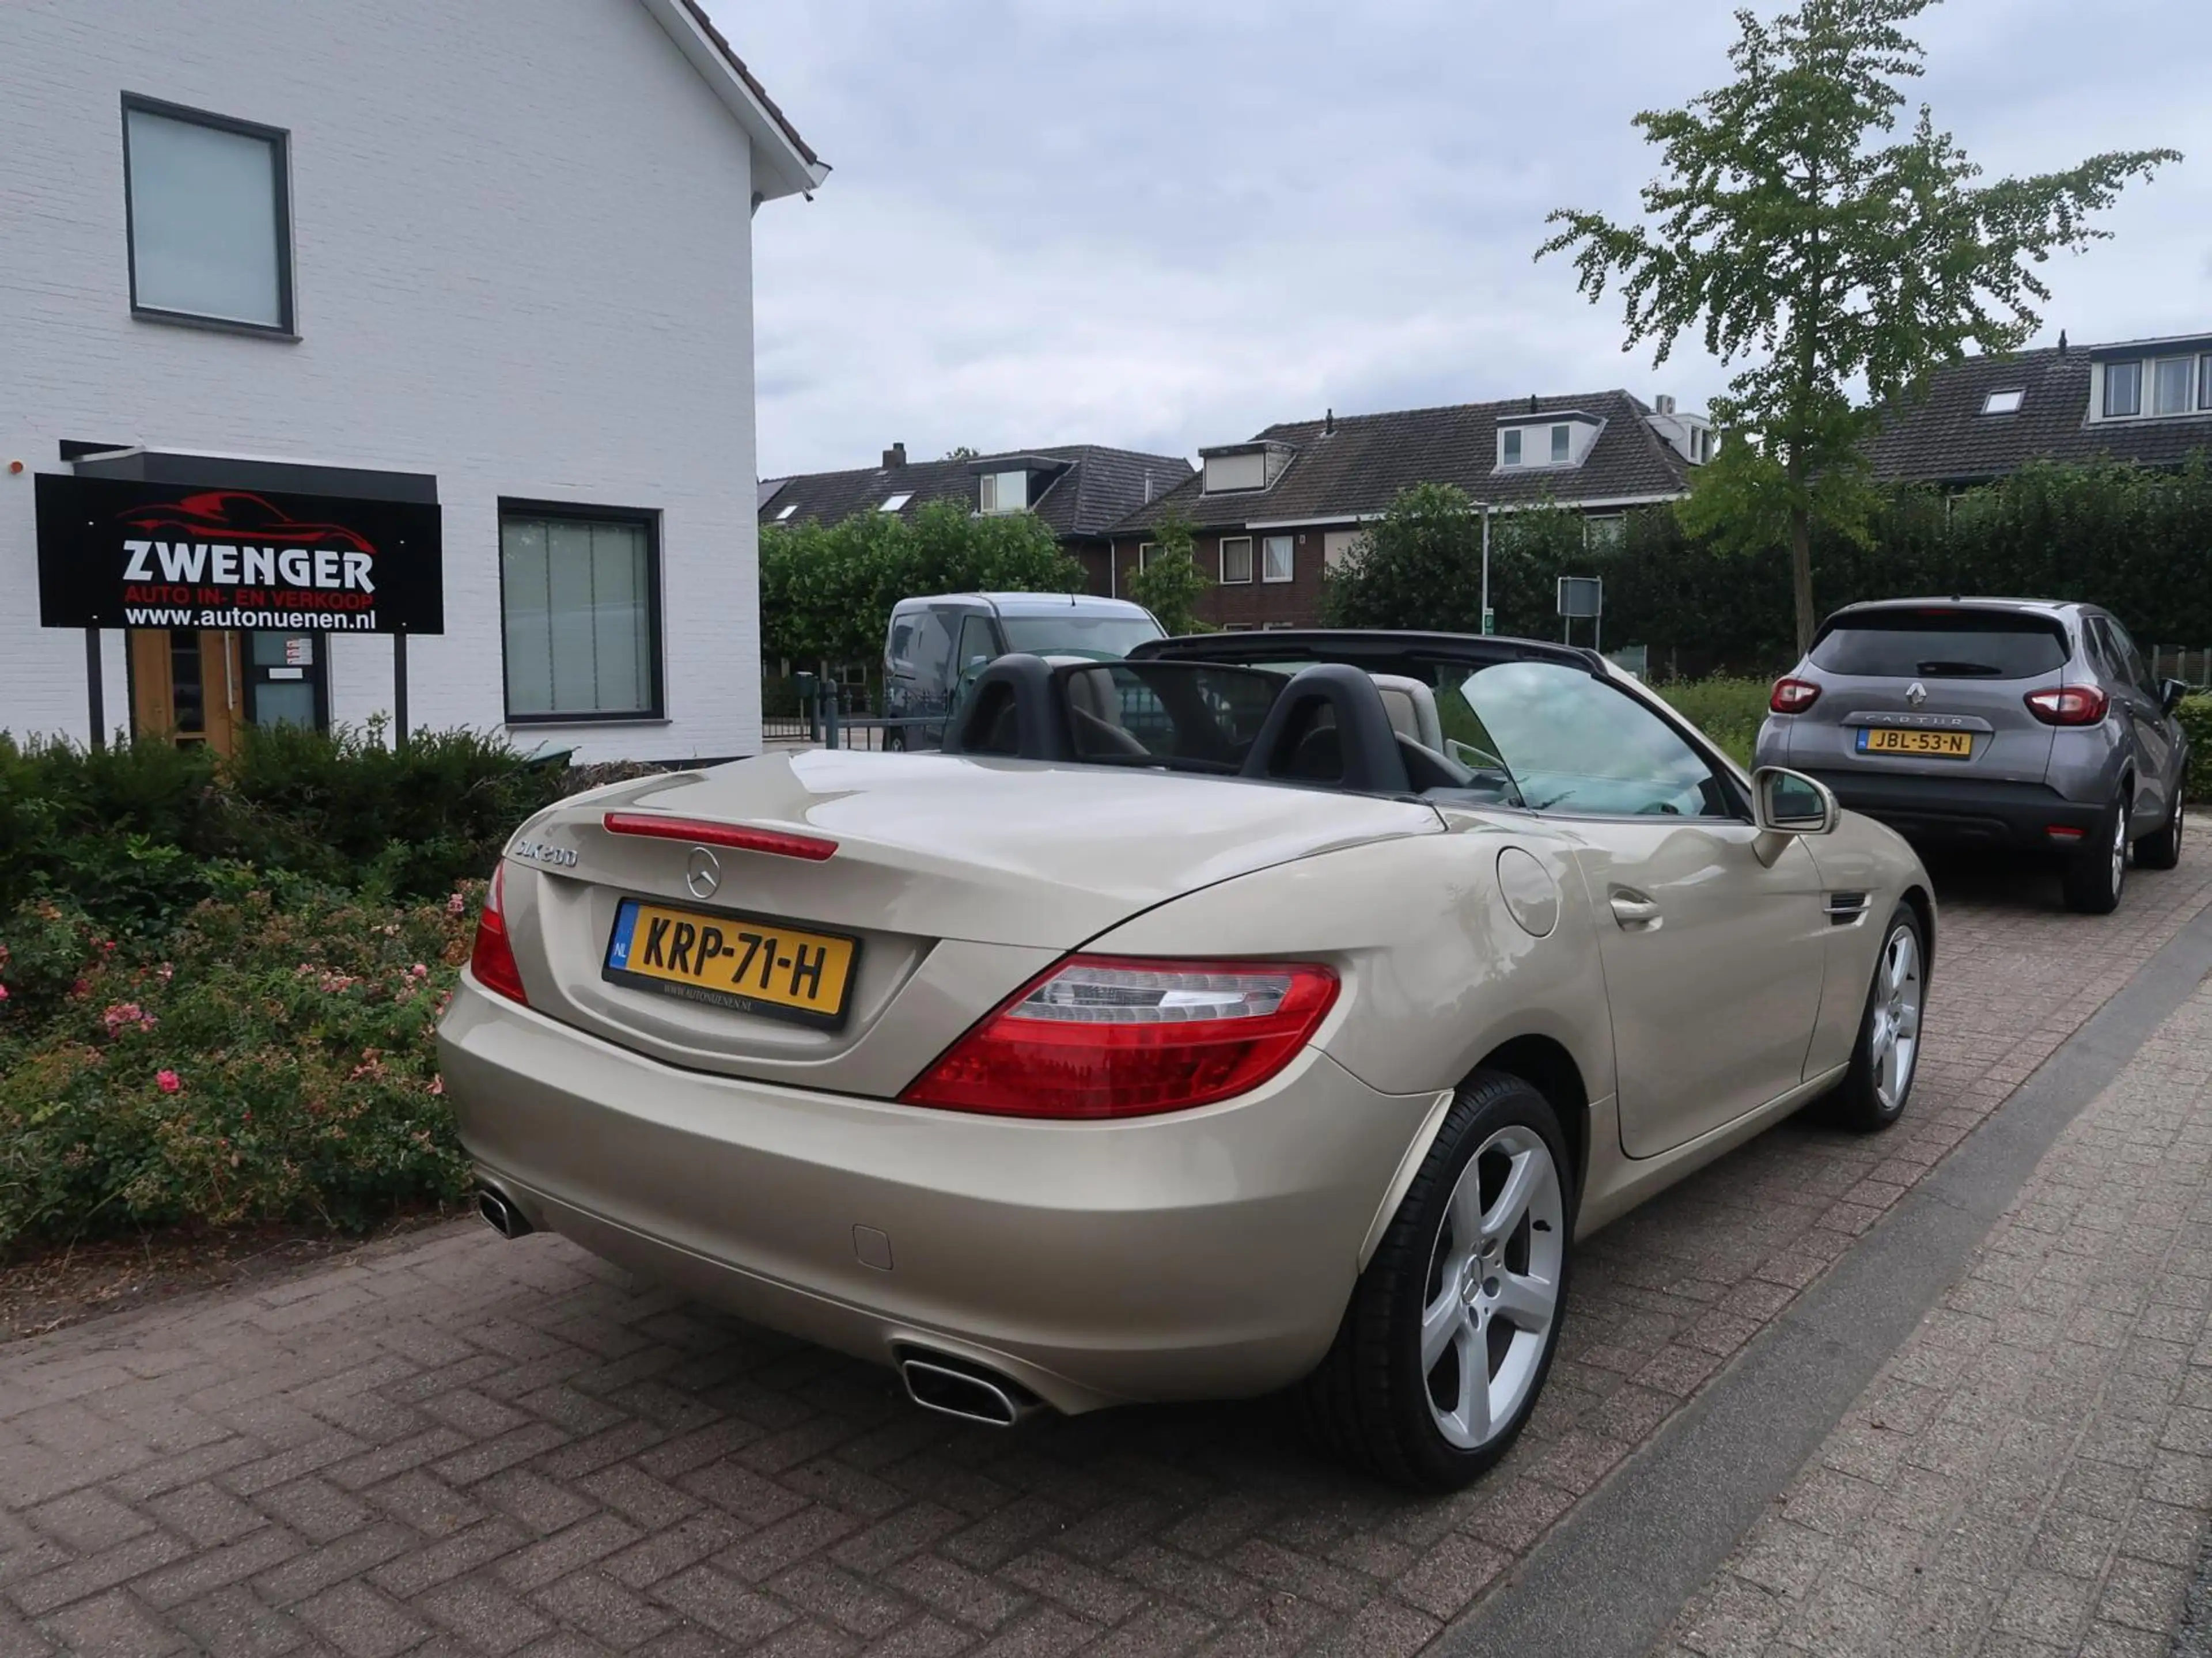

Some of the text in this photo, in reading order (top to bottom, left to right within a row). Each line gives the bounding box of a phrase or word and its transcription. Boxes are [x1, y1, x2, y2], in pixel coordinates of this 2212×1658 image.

[123, 540, 376, 594] ZWENGER
[124, 585, 374, 610] AUTO IN- EN VERKOOP
[125, 608, 376, 629] www.autonuenen.nl
[1865, 715, 1963, 726] CAPTUR
[1876, 732, 1963, 752] JBL-53-N
[613, 942, 627, 958] NL
[643, 917, 827, 1000] KRP-71-H
